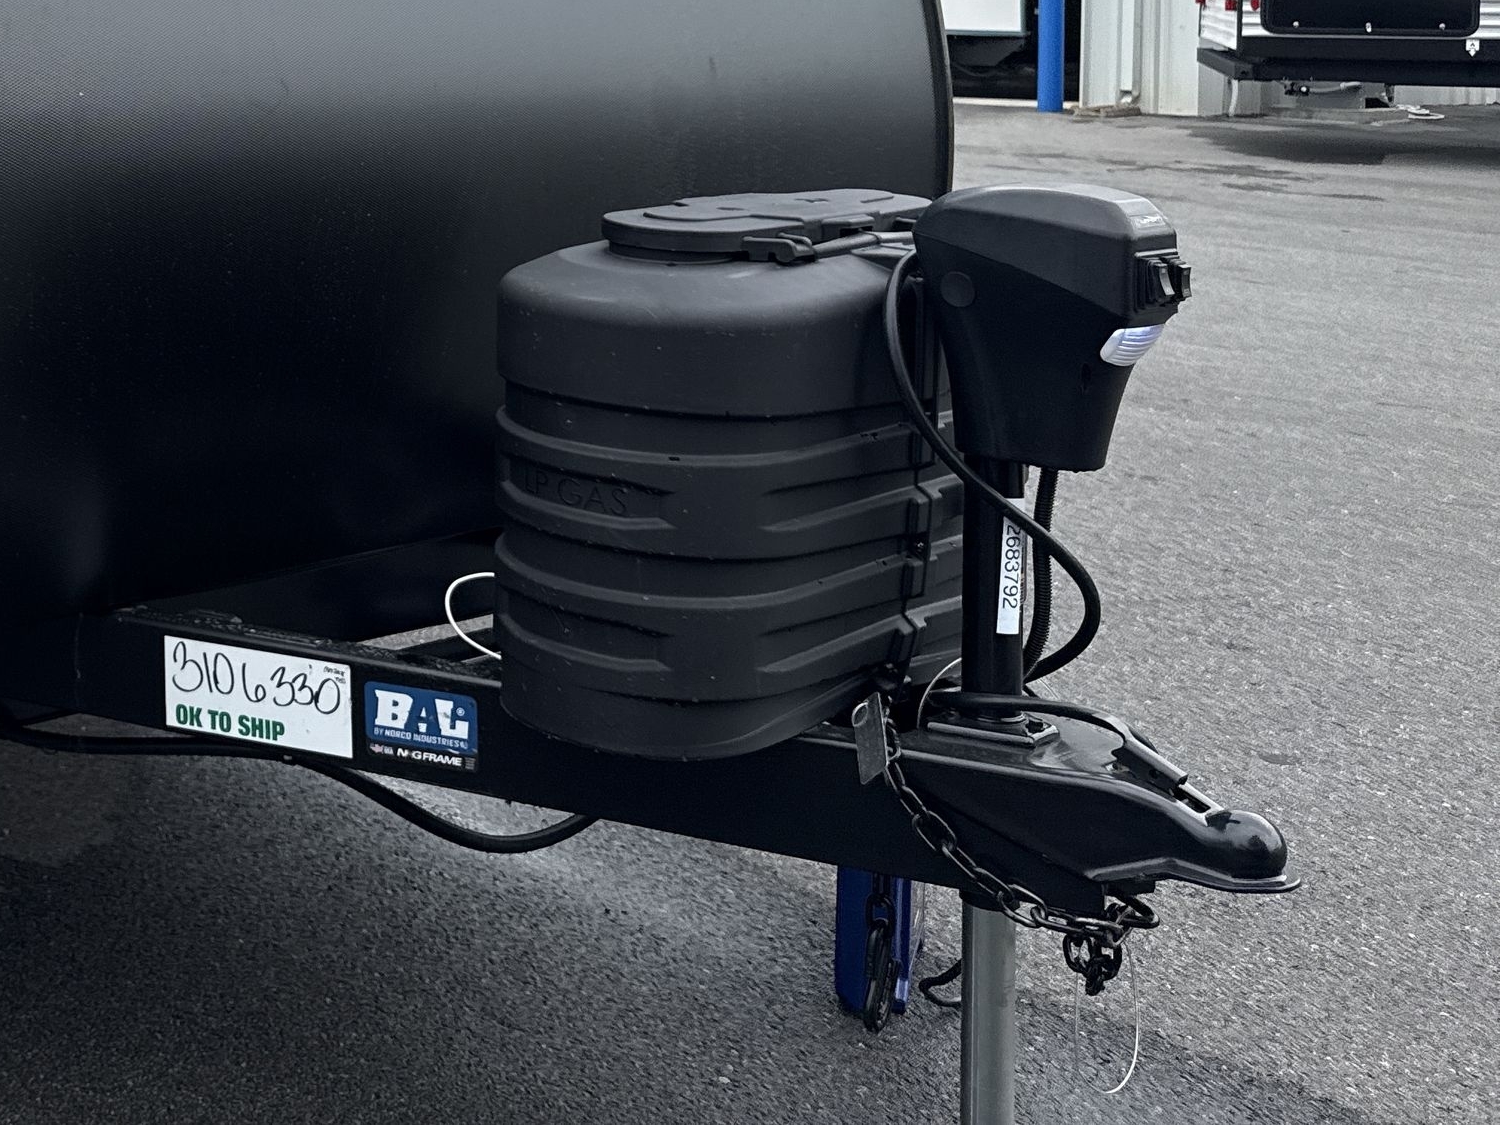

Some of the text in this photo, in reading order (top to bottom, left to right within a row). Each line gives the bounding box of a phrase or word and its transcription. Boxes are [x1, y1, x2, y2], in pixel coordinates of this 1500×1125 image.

[557, 477, 630, 517] GAS
[175, 703, 286, 742] OK TO SHIP
[373, 726, 384, 736] BY
[385, 728, 412, 741] NORCO
